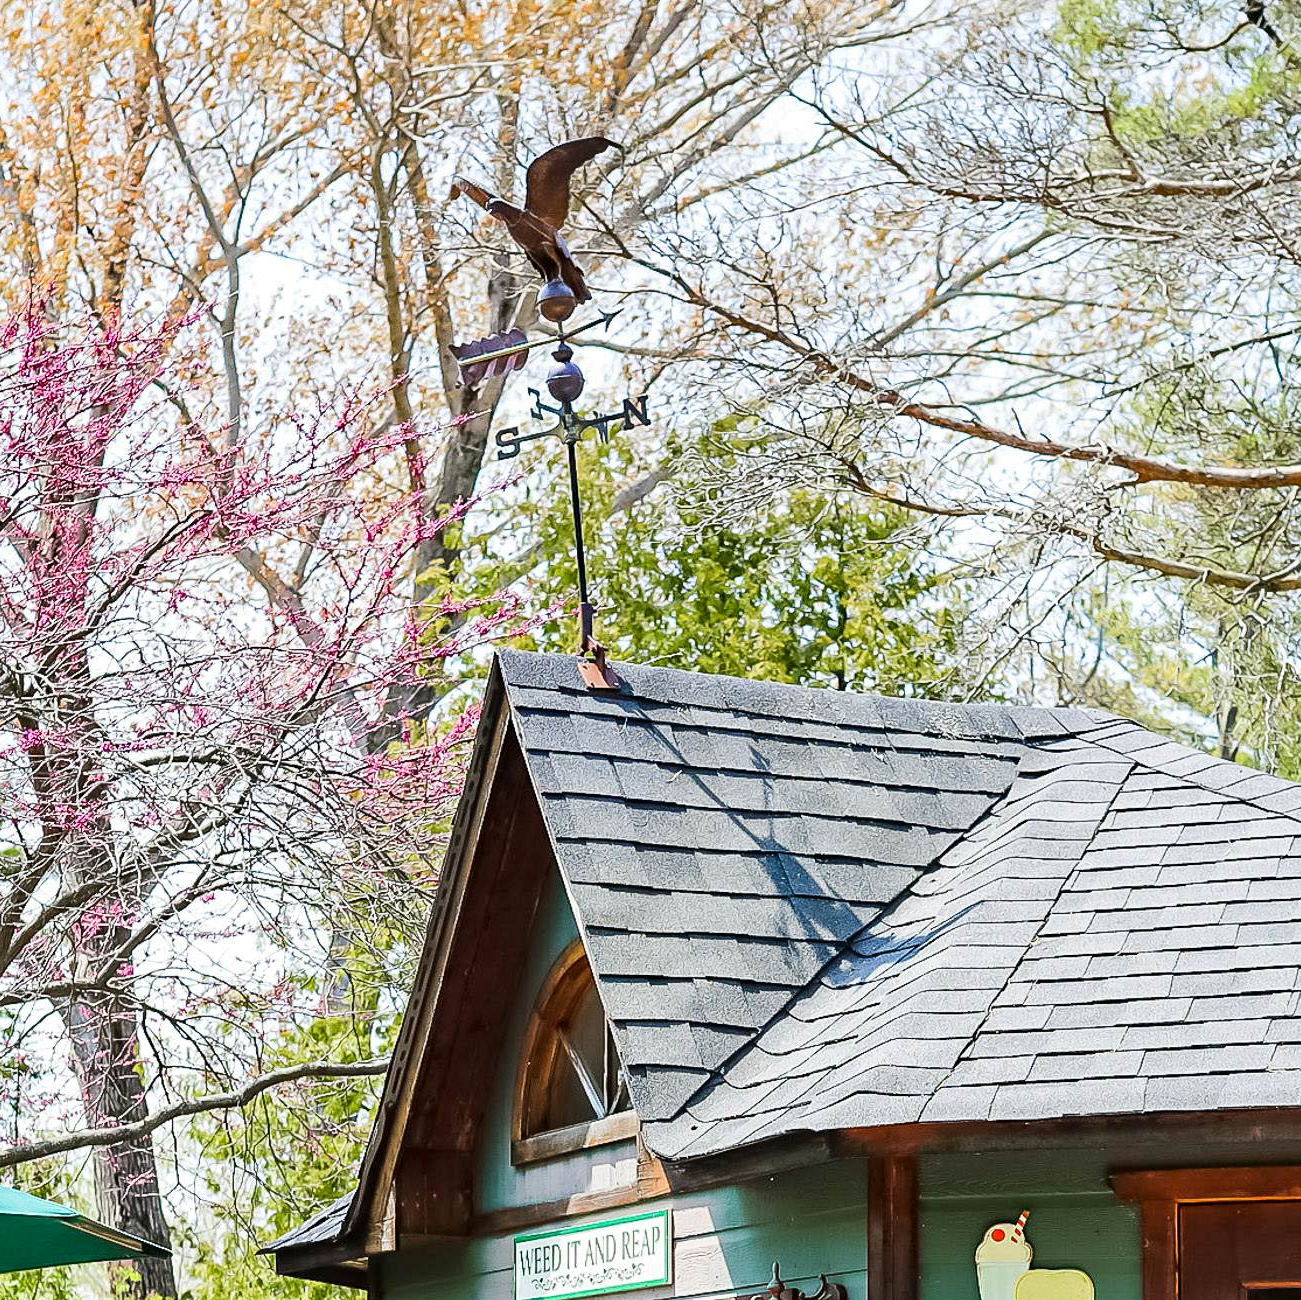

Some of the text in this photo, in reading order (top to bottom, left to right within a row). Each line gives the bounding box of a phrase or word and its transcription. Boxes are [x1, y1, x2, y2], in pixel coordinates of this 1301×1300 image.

[623, 395, 651, 431] N
[520, 1226, 660, 1276] WEED IT AND REAP
